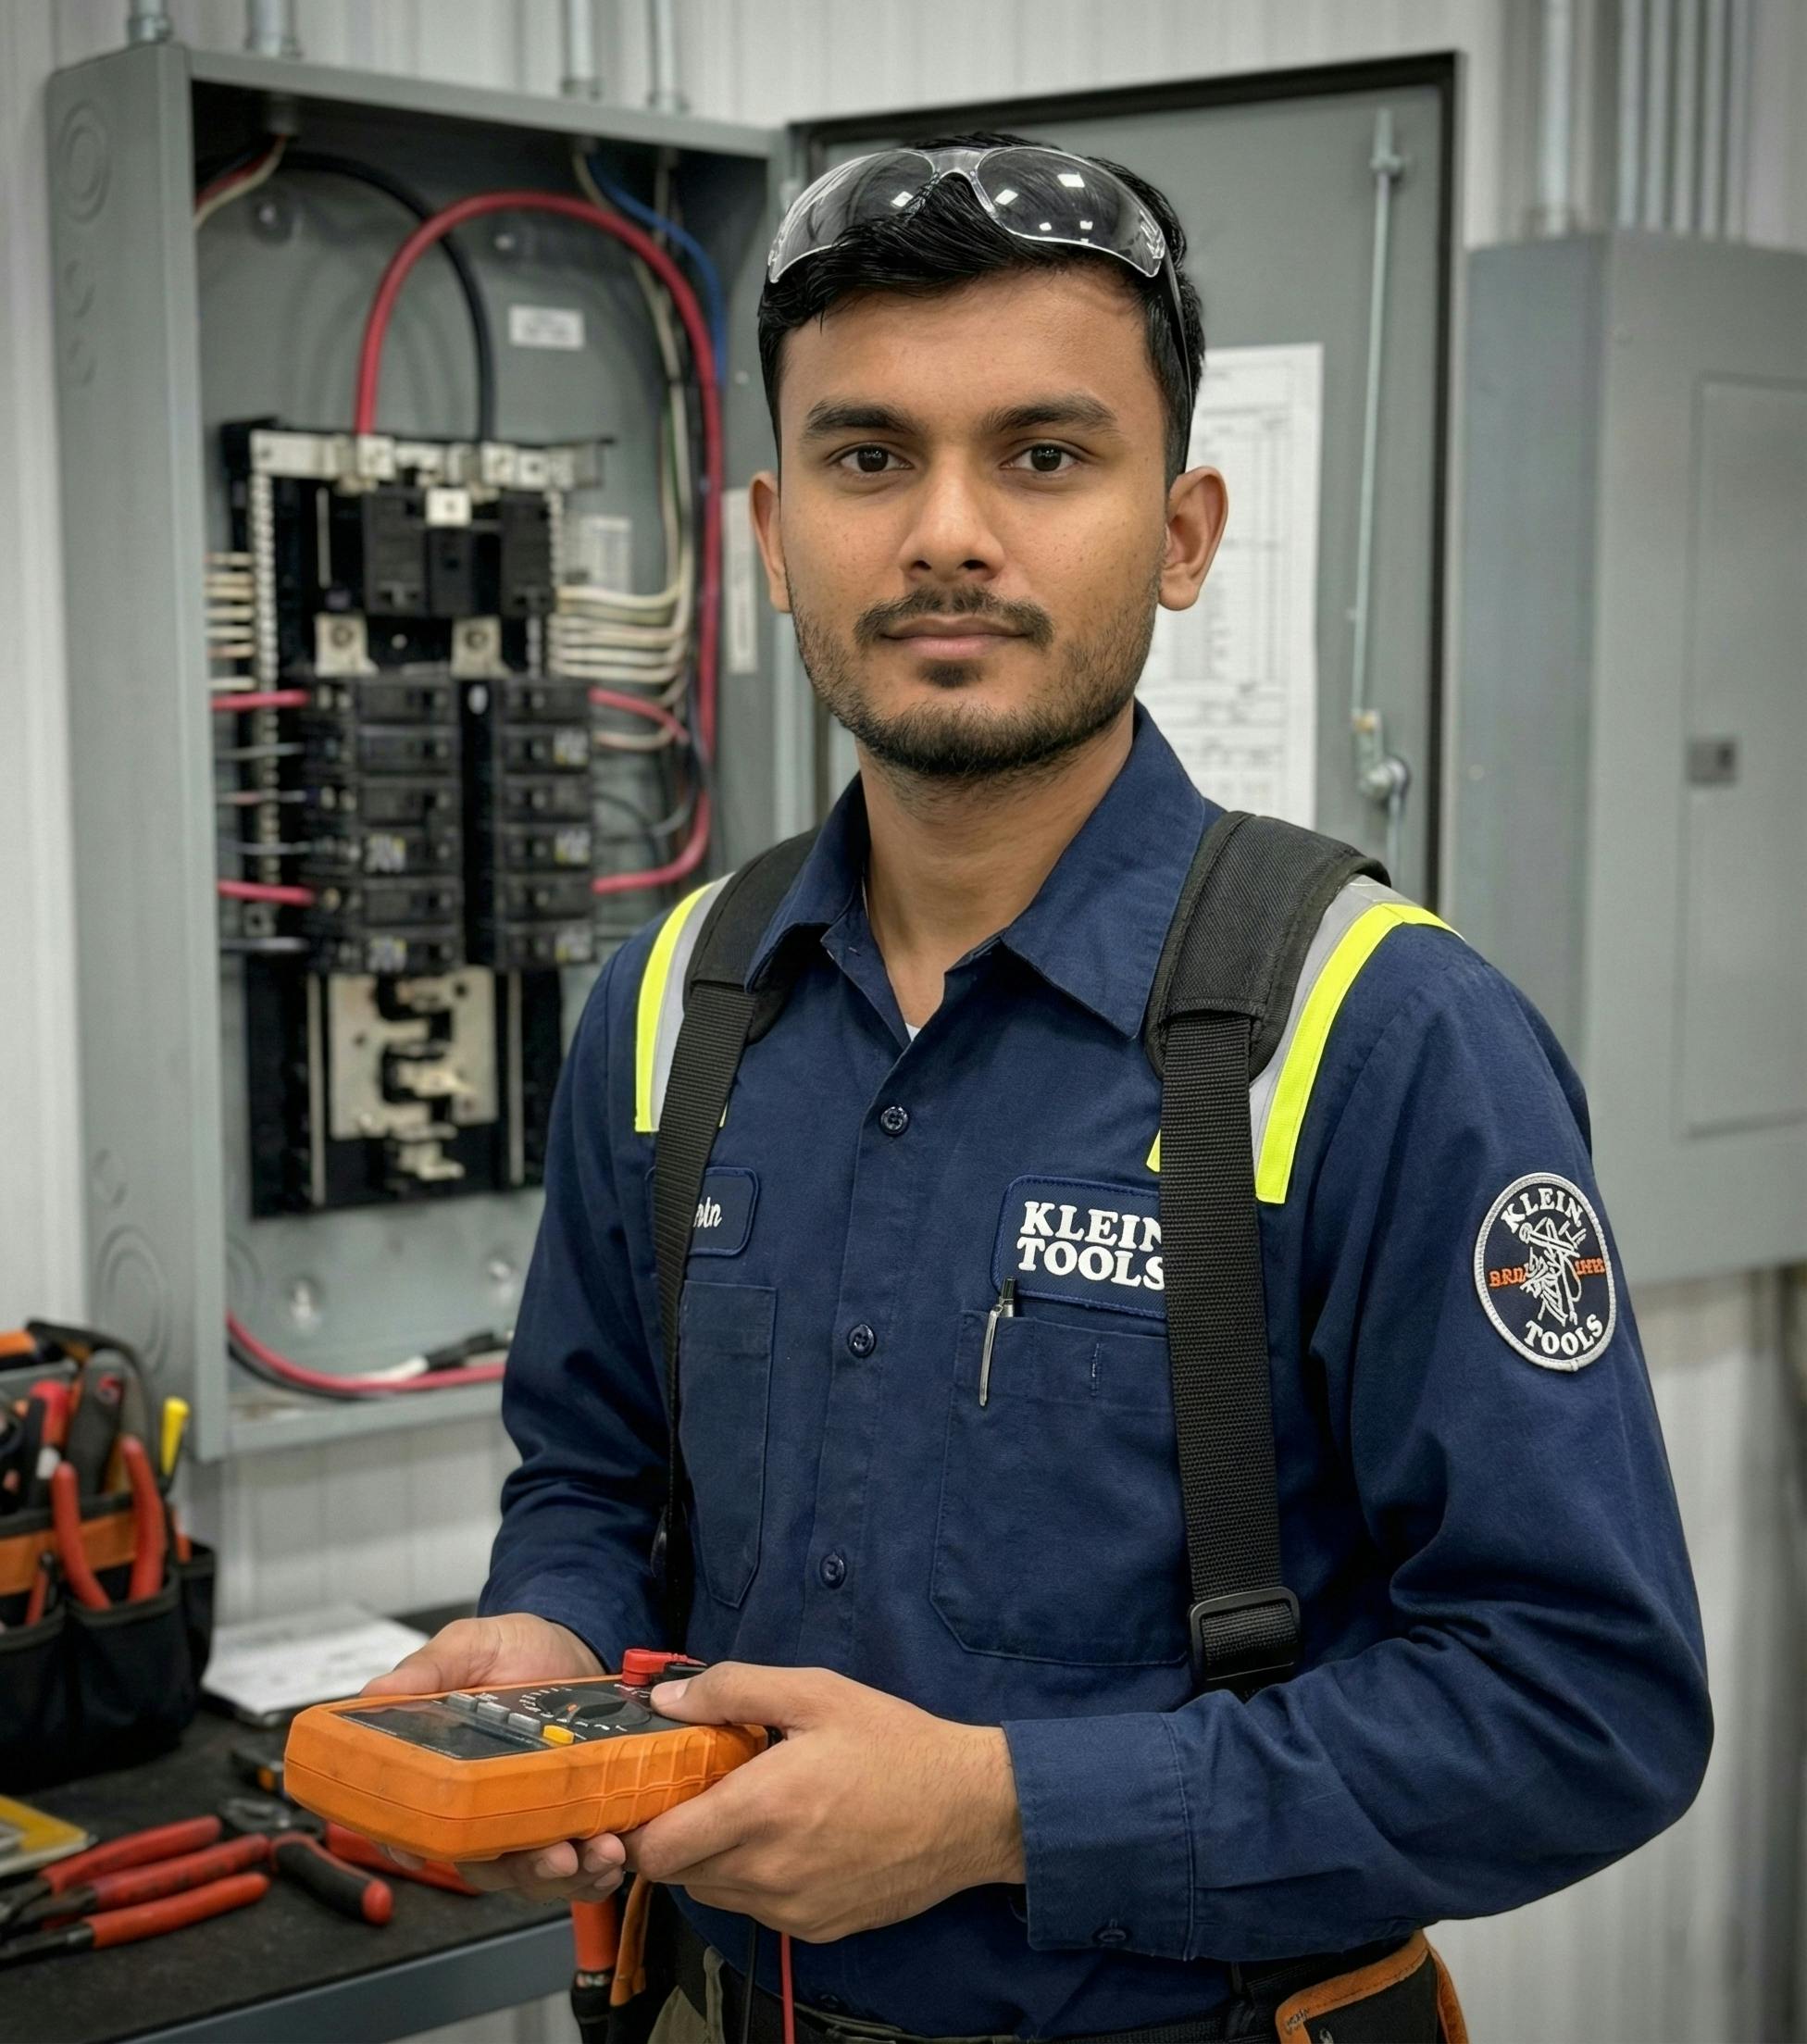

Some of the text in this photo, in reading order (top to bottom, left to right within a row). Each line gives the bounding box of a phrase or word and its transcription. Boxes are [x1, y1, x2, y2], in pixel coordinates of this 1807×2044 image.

[1501, 1188, 1582, 1233] KLEIN
[1016, 1236, 1165, 1290] TOOLS
[1525, 1314, 1603, 1355] TOOLS
